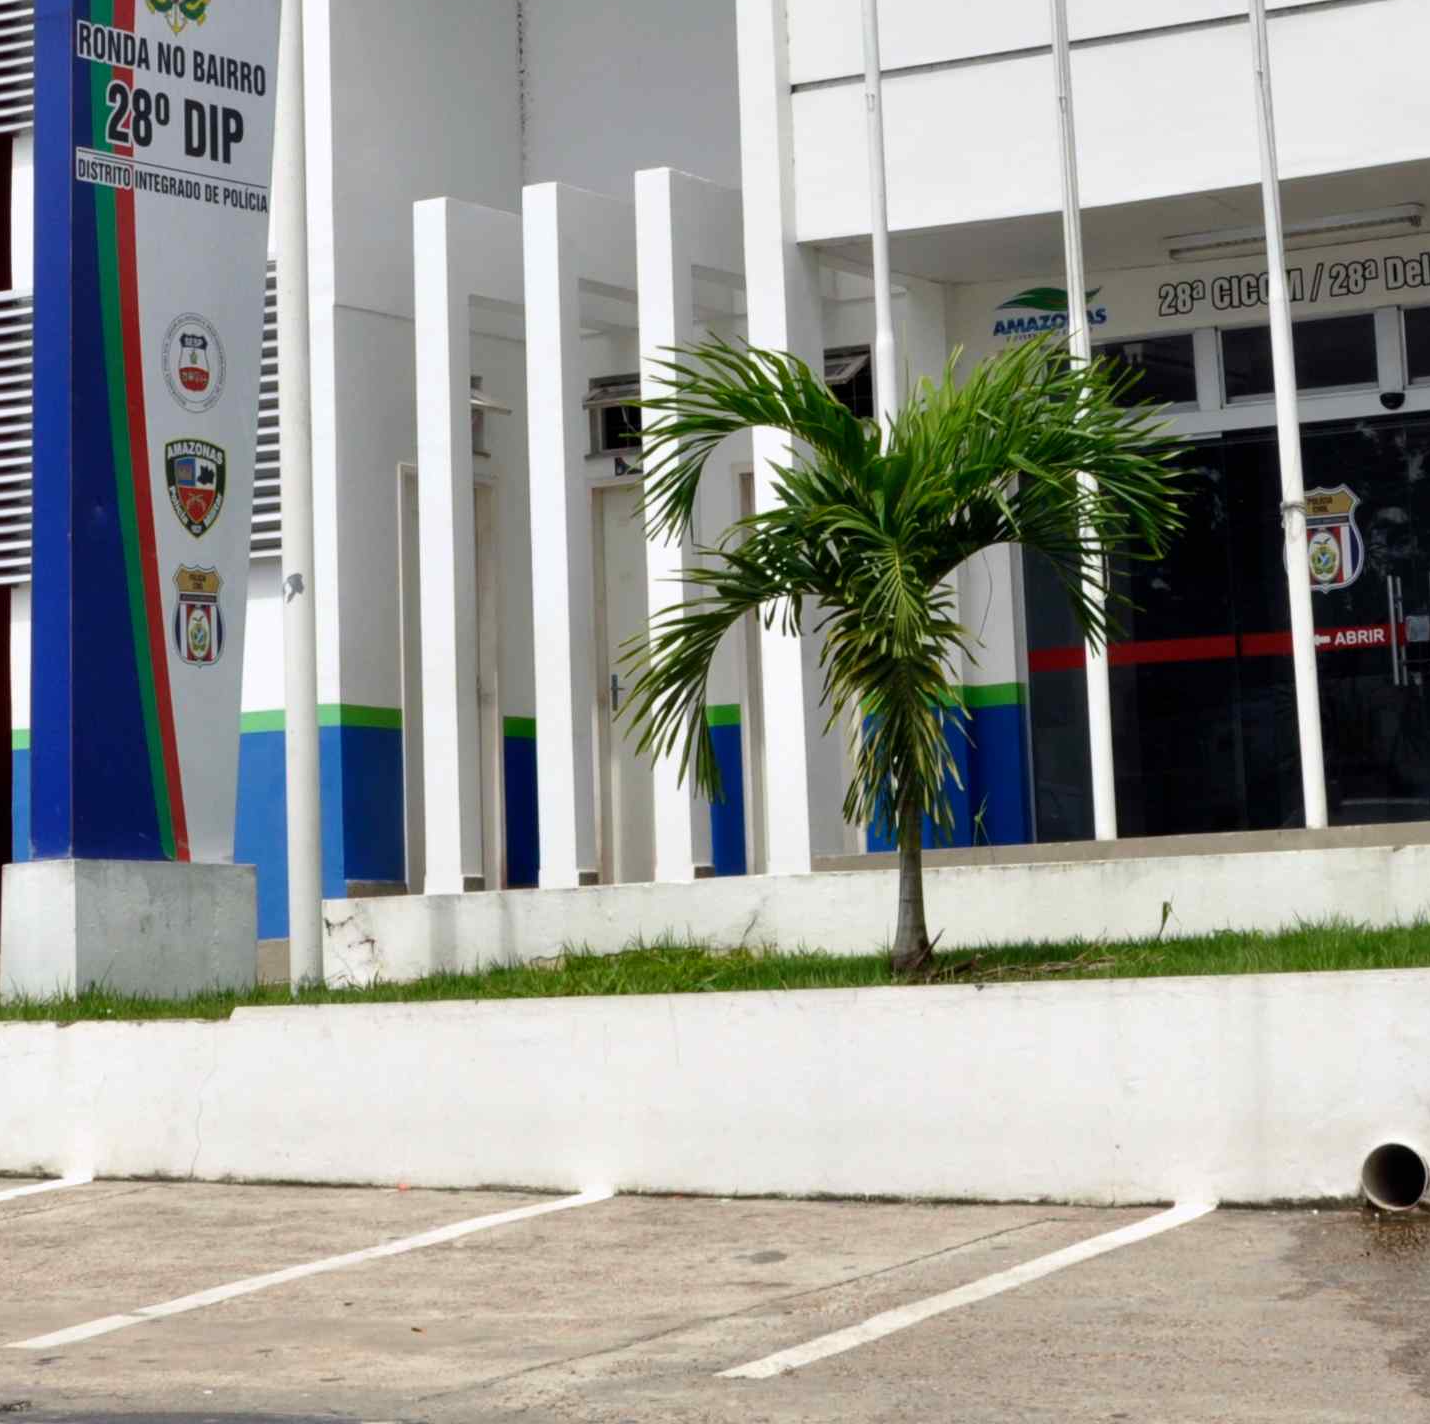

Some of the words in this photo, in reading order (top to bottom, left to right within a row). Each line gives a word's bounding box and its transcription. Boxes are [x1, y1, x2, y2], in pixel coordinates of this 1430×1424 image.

[78, 22, 150, 71] RONDA
[157, 43, 186, 79] NO
[193, 52, 267, 97] BAIRRO
[106, 83, 171, 149] 28º
[184, 99, 245, 165] DIP
[77, 158, 131, 188] DISTRITO
[134, 170, 202, 202] INTEGRADO
[204, 187, 220, 204] DE
[223, 187, 268, 214] POLÍCIA
[1310, 263, 1323, 302] /
[168, 442, 224, 465] AMAZONAS
[1334, 628, 1385, 646] ABRIR
